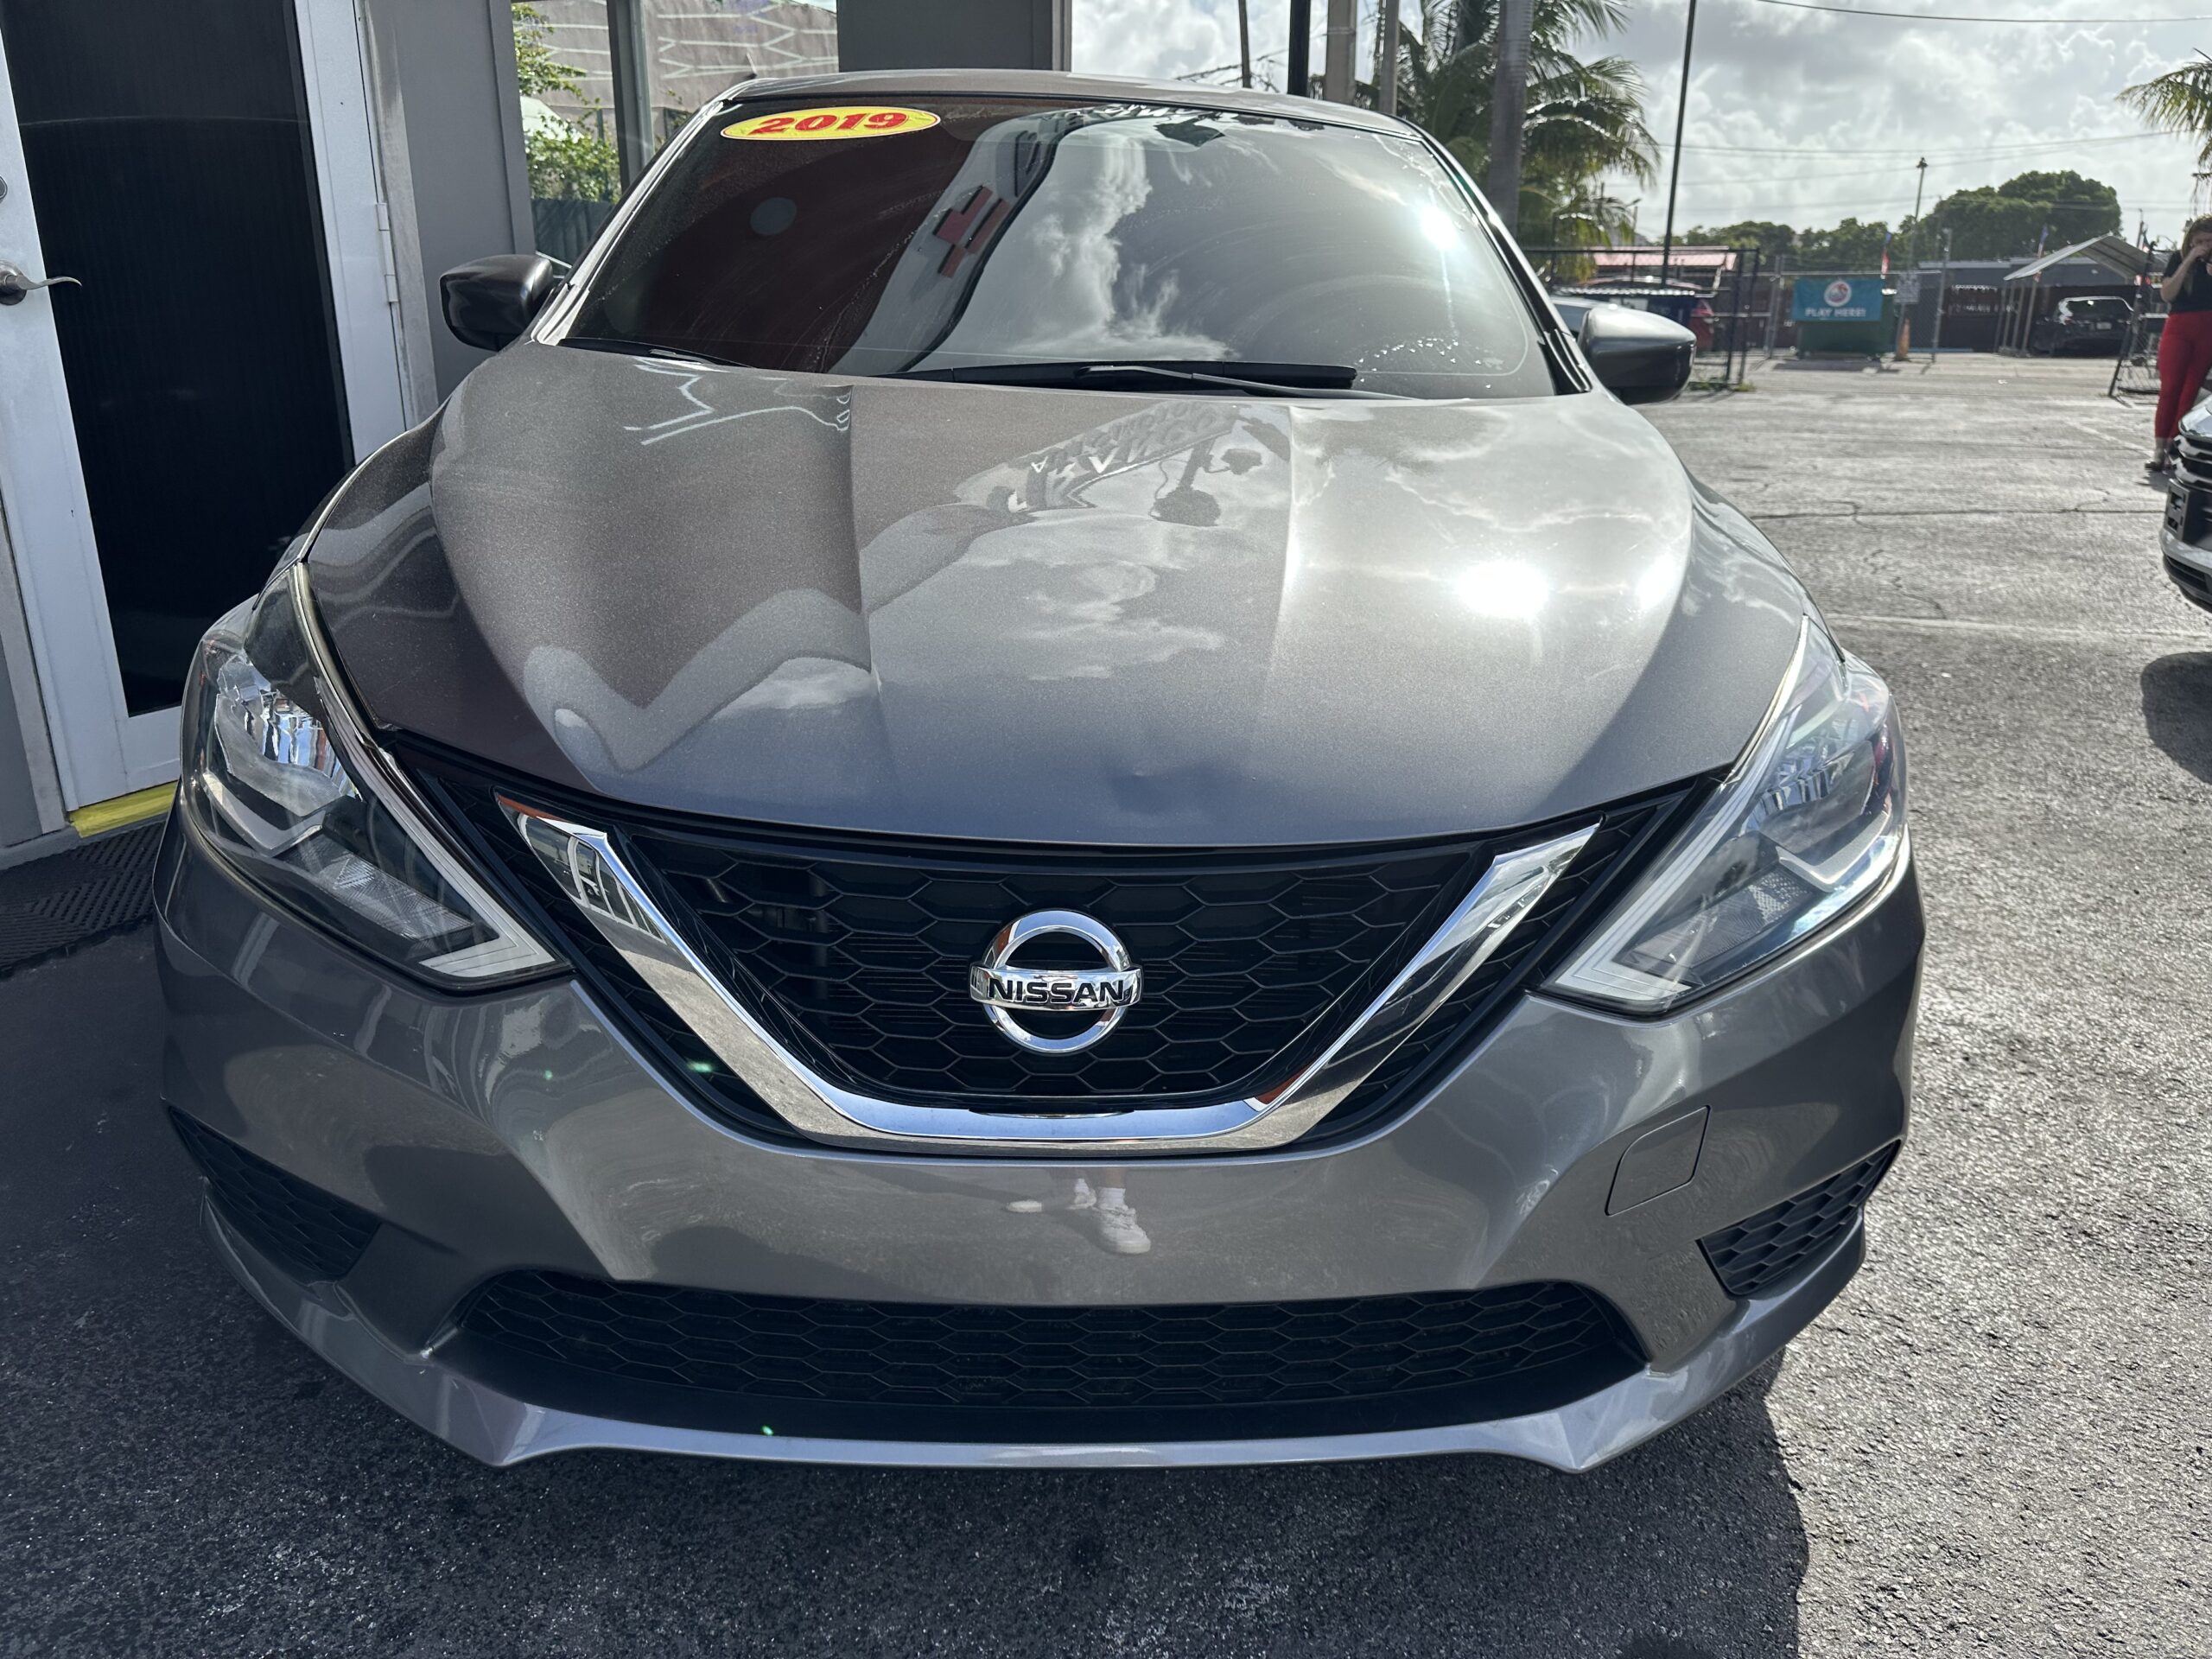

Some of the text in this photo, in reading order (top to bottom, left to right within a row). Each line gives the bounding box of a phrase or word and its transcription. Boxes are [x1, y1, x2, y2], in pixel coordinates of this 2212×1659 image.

[747, 112, 908, 136] 2019
[1805, 308, 1866, 317] PLAY HERE!
[988, 979, 1124, 1003] NISSAN
